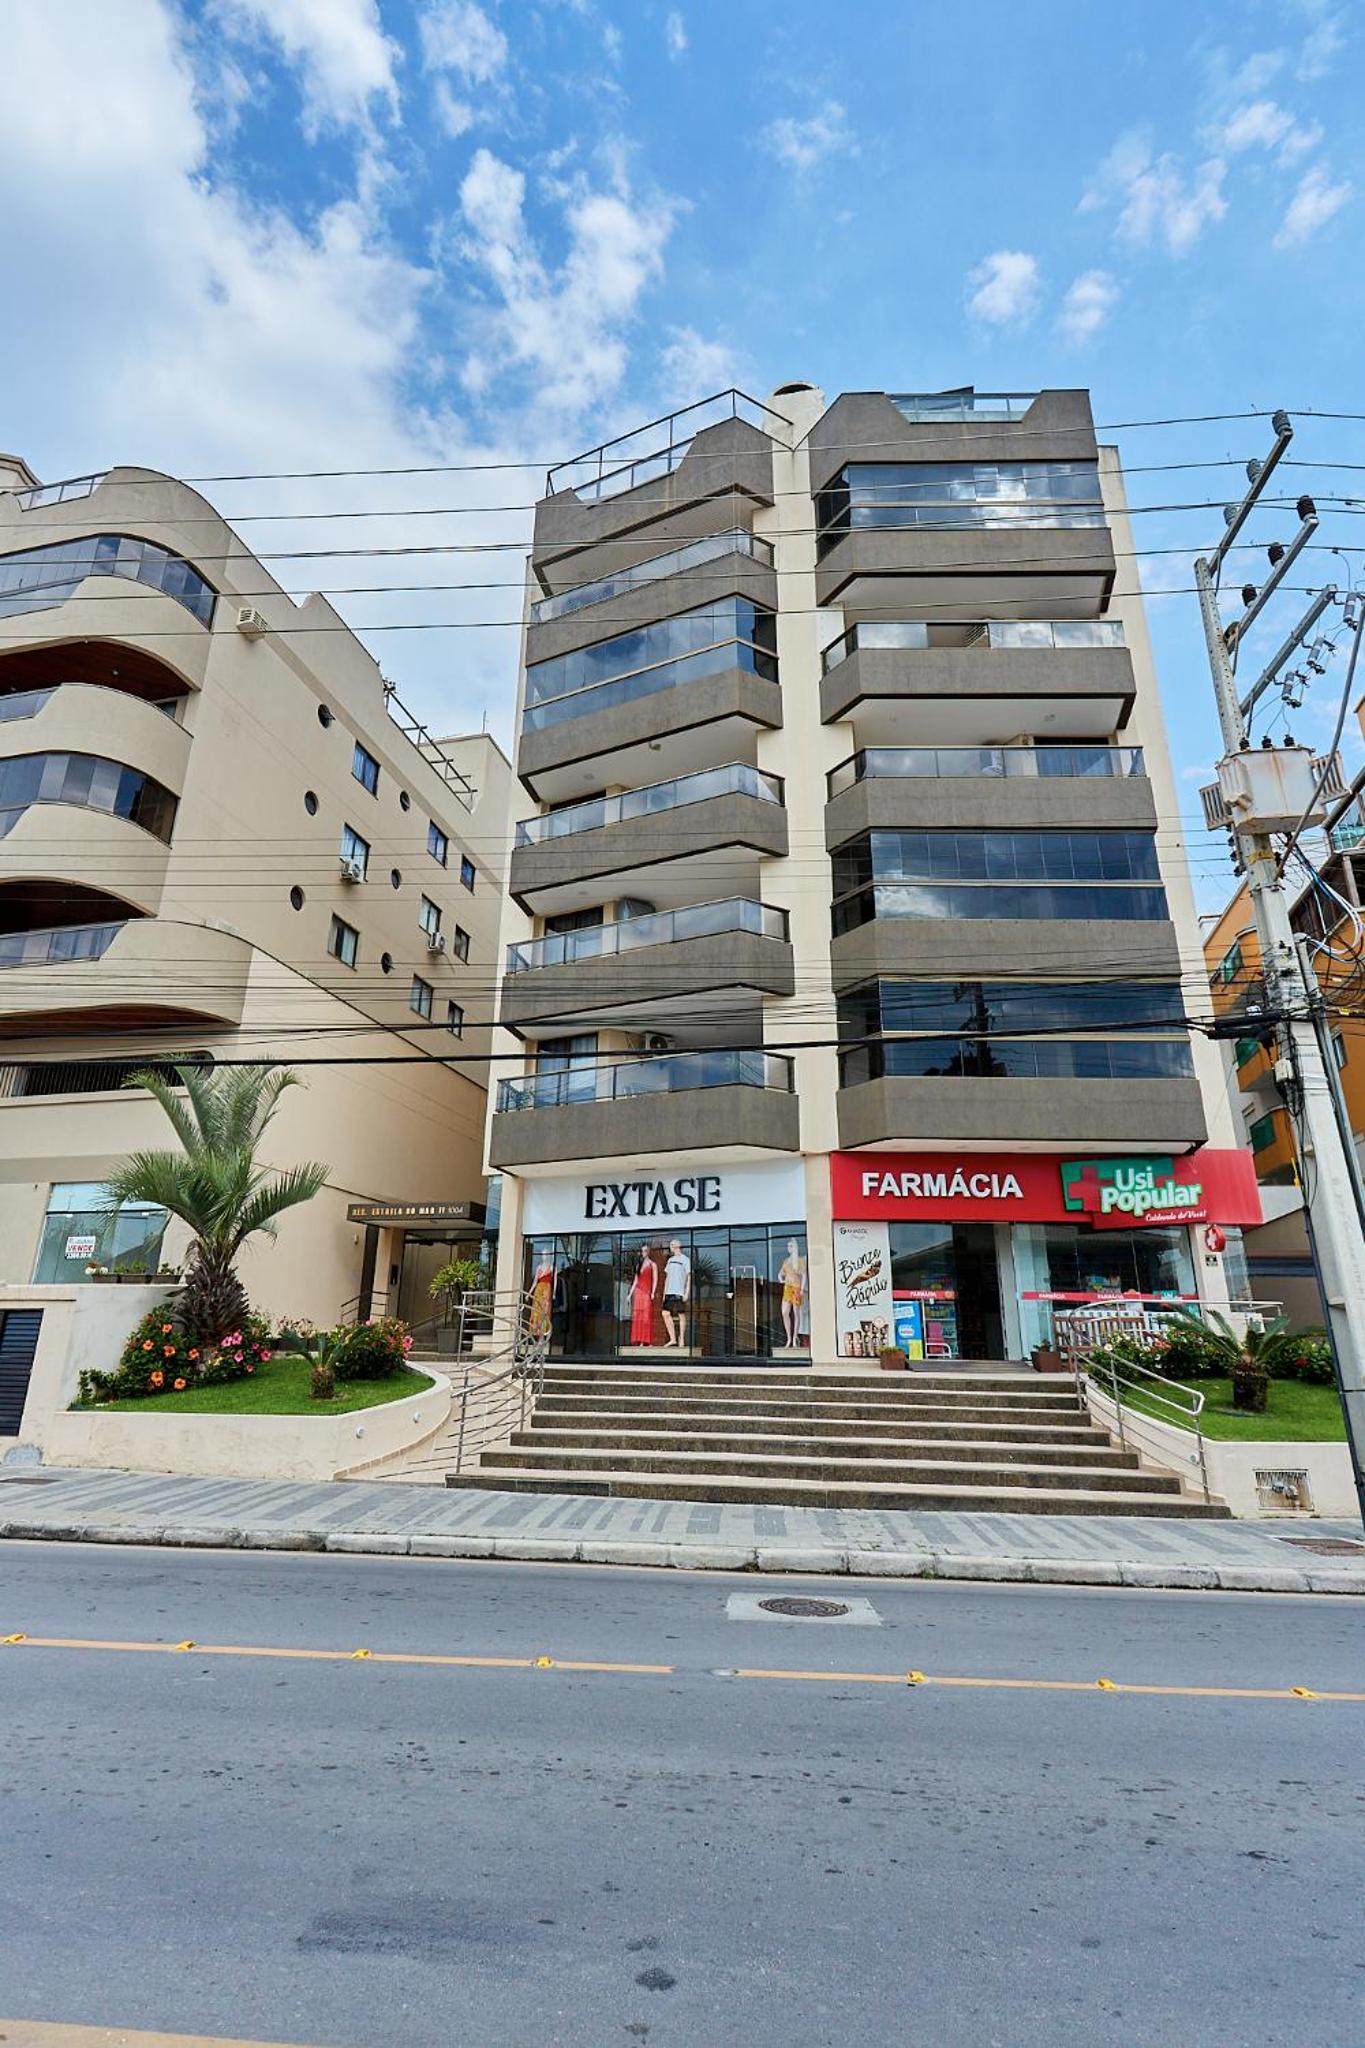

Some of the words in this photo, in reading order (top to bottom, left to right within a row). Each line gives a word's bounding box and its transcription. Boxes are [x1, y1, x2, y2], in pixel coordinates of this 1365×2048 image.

[584, 1176, 721, 1218] EXTASE
[862, 1168, 1025, 1198] FARMÁCIA
[1115, 1166, 1154, 1191] Usi
[1101, 1180, 1202, 1217] Popular
[838, 1248, 881, 1285] Bronze
